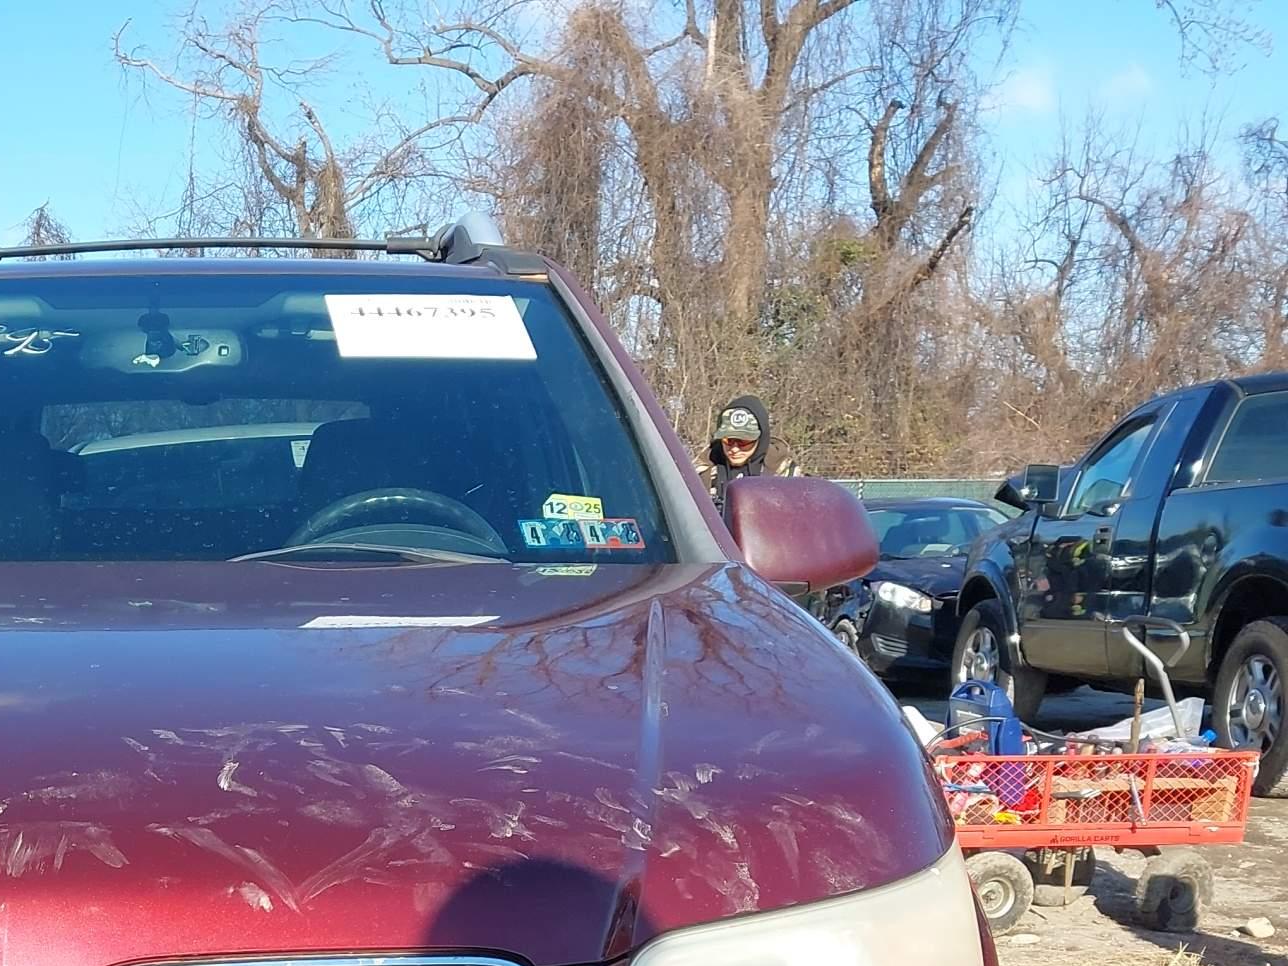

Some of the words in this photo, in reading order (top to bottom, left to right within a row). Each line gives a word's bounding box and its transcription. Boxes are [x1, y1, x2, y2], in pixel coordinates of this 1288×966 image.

[545, 502, 568, 515] 12
[584, 502, 601, 514] 25
[531, 527, 541, 544] 4
[589, 525, 600, 543] 4
[1060, 835, 1092, 843] GORILLA
